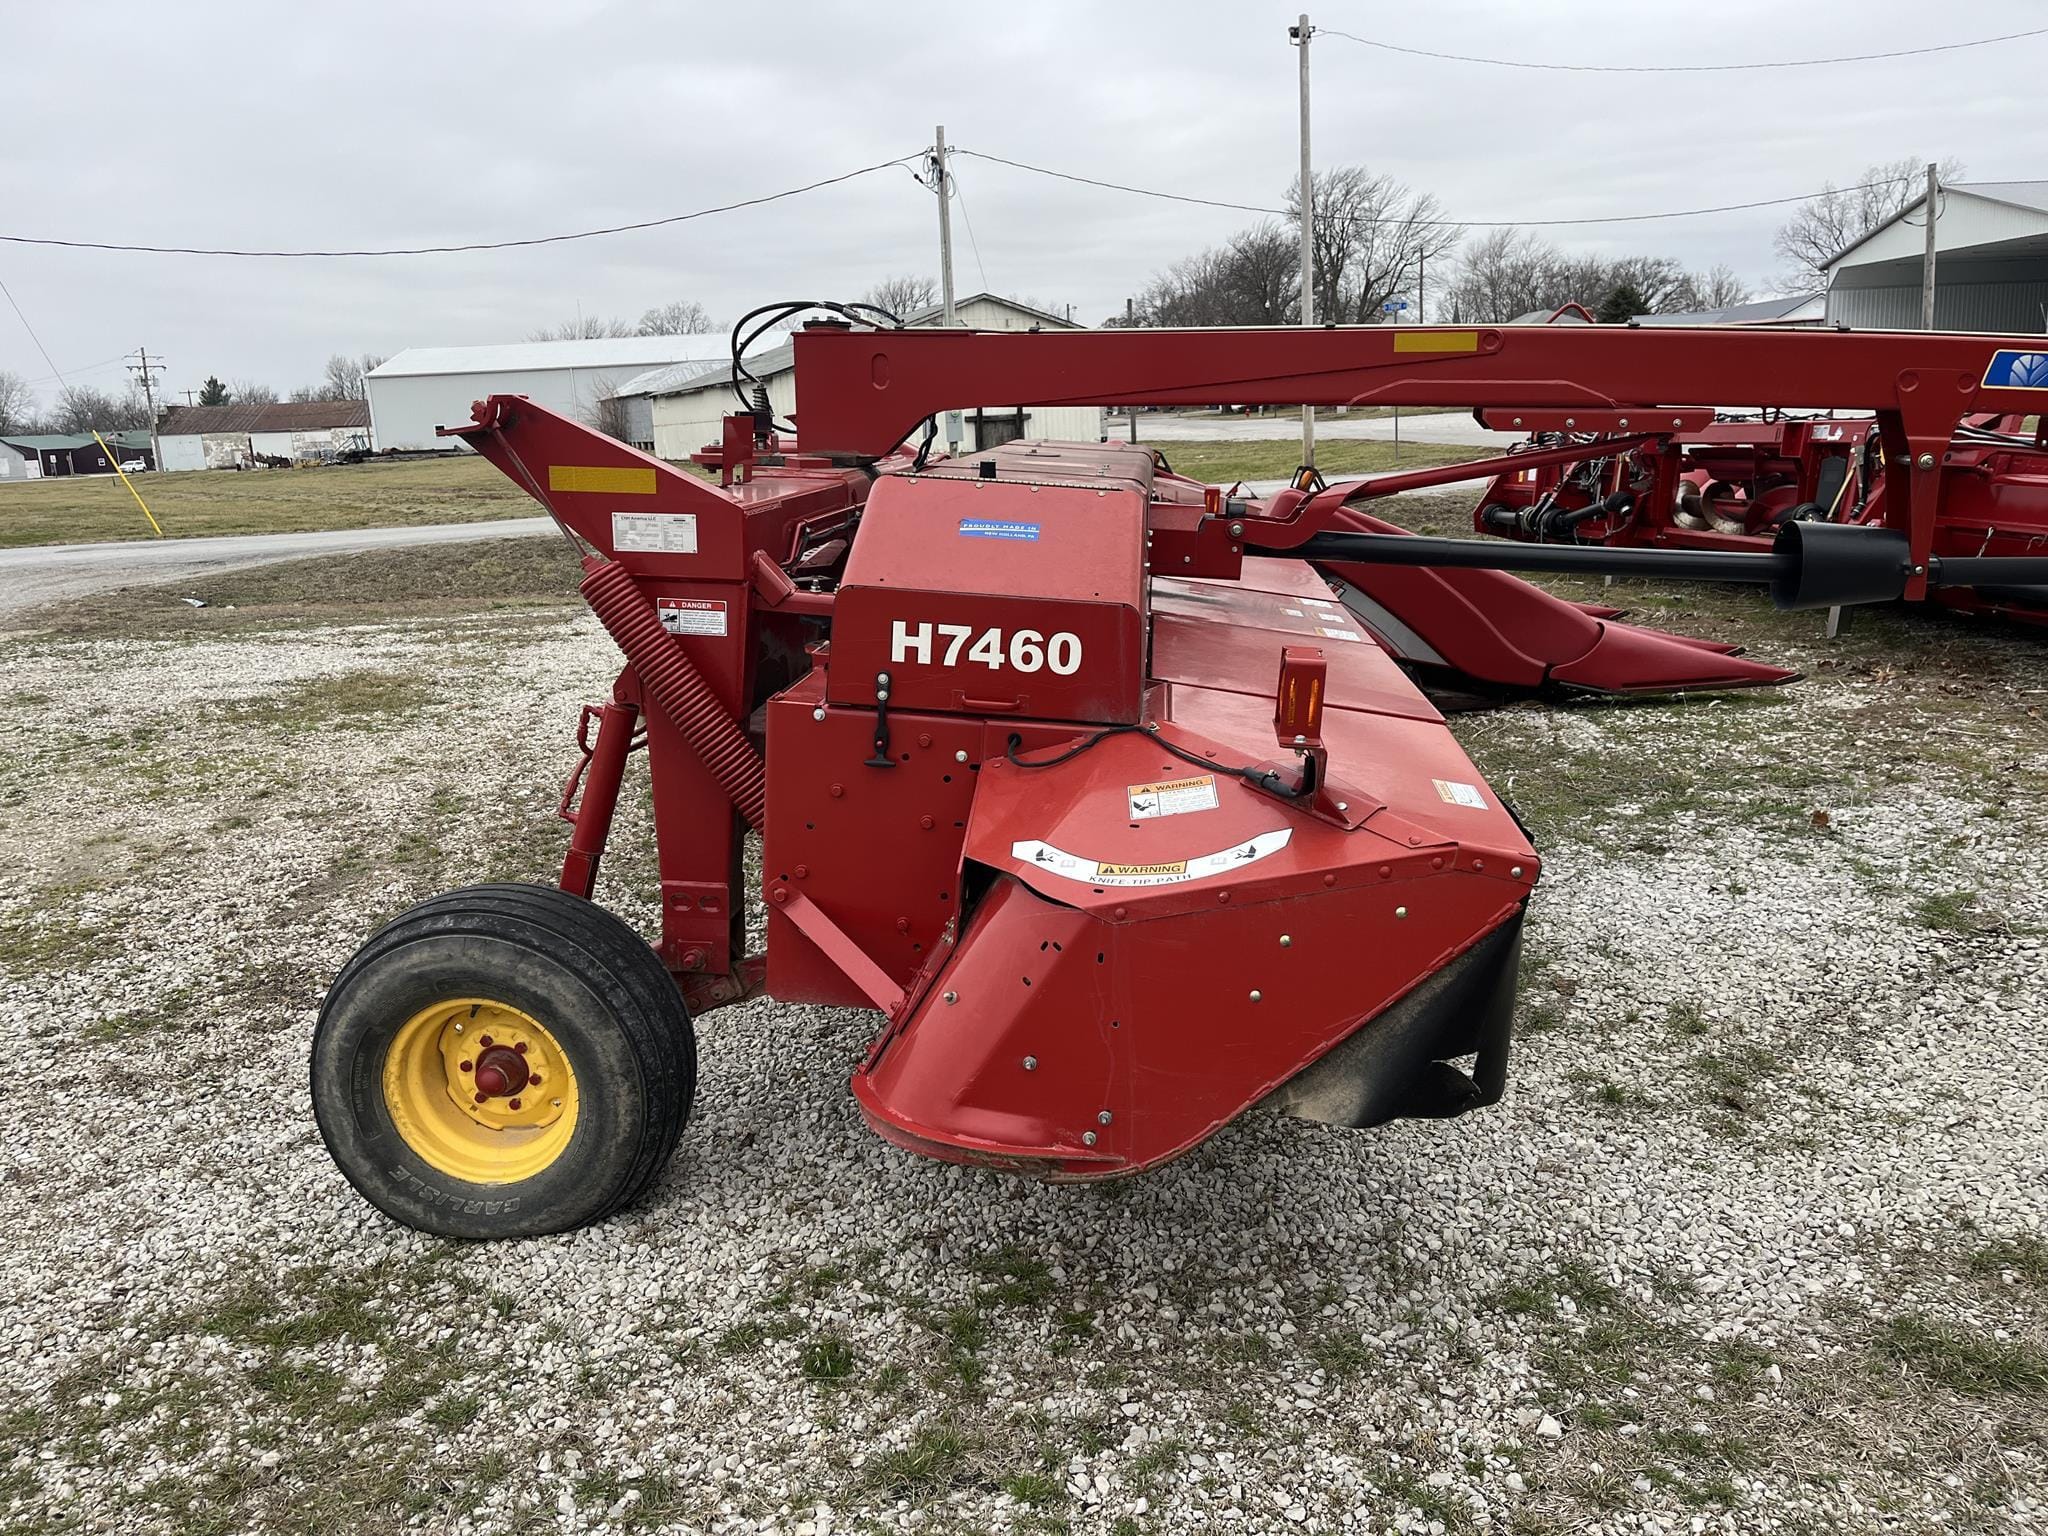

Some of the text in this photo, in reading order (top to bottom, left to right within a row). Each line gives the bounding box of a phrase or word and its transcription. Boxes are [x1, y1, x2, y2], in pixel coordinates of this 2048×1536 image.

[891, 620, 1082, 676] H7460
[1155, 779, 1204, 791] WARNING
[1118, 865, 1181, 874] WARNING
[387, 1164, 521, 1216] CARLISLE
